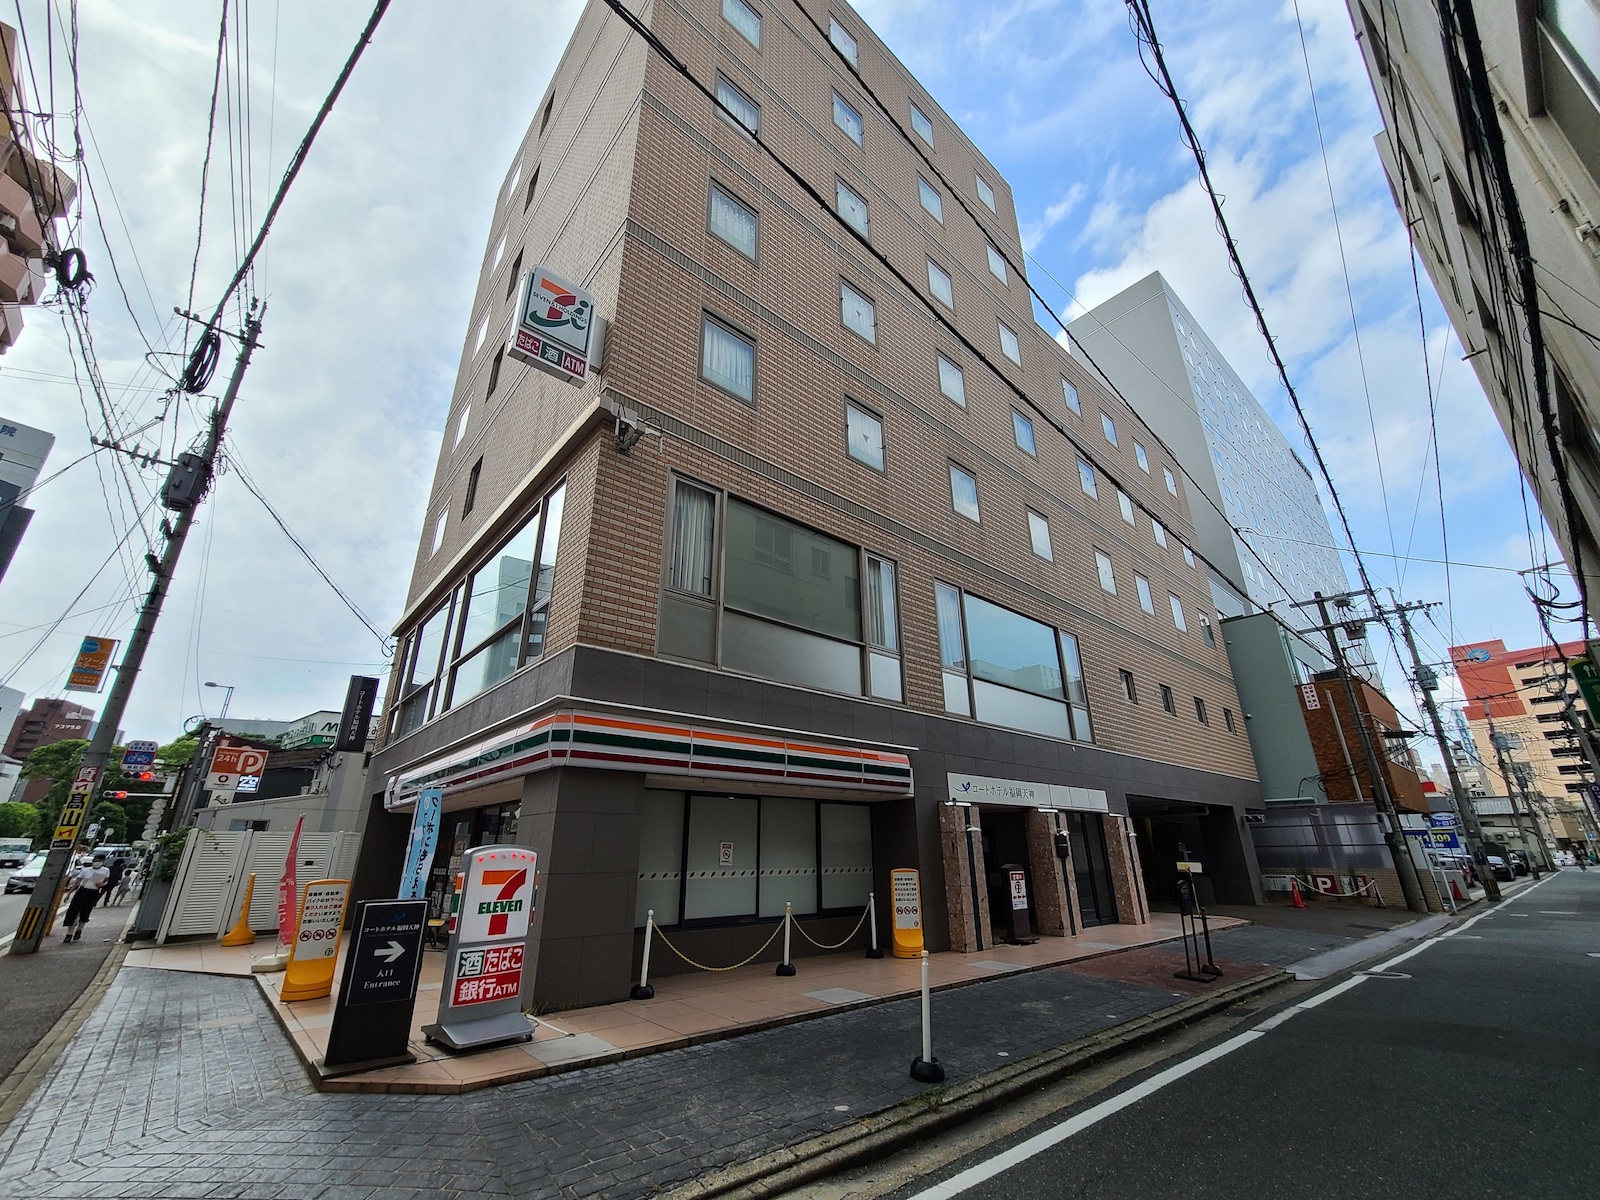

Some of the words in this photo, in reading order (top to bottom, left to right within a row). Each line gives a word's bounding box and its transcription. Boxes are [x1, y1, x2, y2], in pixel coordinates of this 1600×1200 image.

[516, 333, 540, 353] たばこ
[544, 345, 560, 364] 酒
[564, 355, 586, 376] ATM
[217, 754, 238, 763] 24h
[972, 784, 1036, 801] コートホテル福岡天神
[1316, 877, 1332, 894] P
[459, 952, 484, 977] 酒
[484, 947, 523, 974] たばこ
[376, 968, 394, 978] 入口
[363, 980, 401, 990] Entrance
[458, 977, 518, 1002] 銀行ATM
